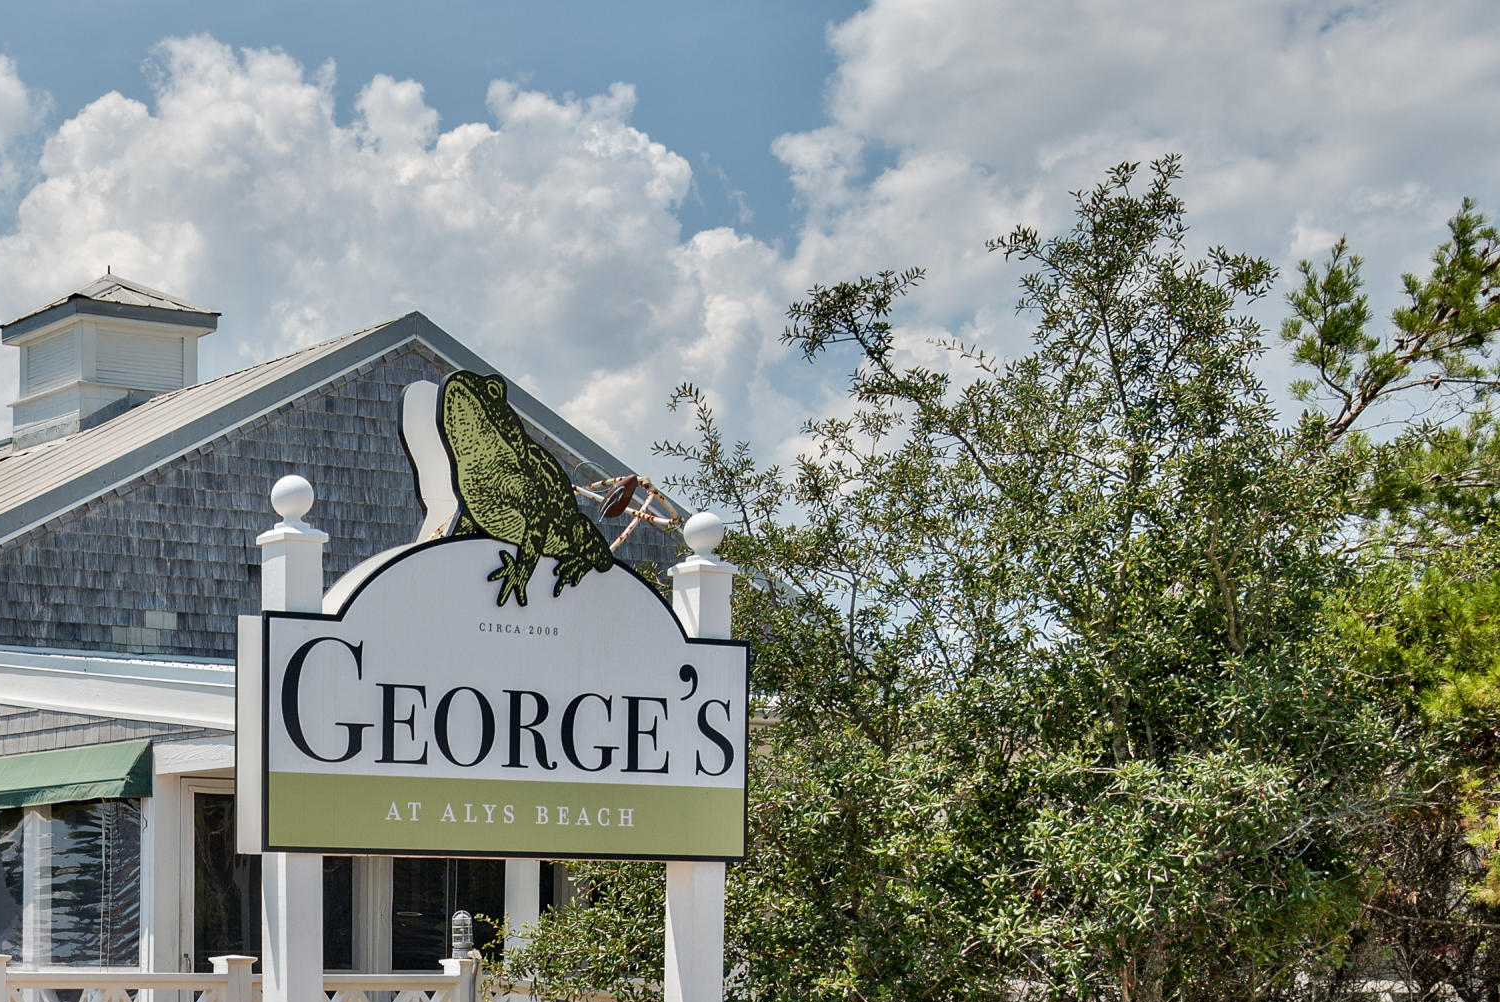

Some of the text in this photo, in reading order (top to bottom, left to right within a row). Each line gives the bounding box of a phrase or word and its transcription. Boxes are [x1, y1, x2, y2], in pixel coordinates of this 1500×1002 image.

[479, 622, 558, 636] CIRCA 2008
[281, 636, 735, 777] GEORGE'S
[385, 801, 635, 827] AT ALYS BEACH
